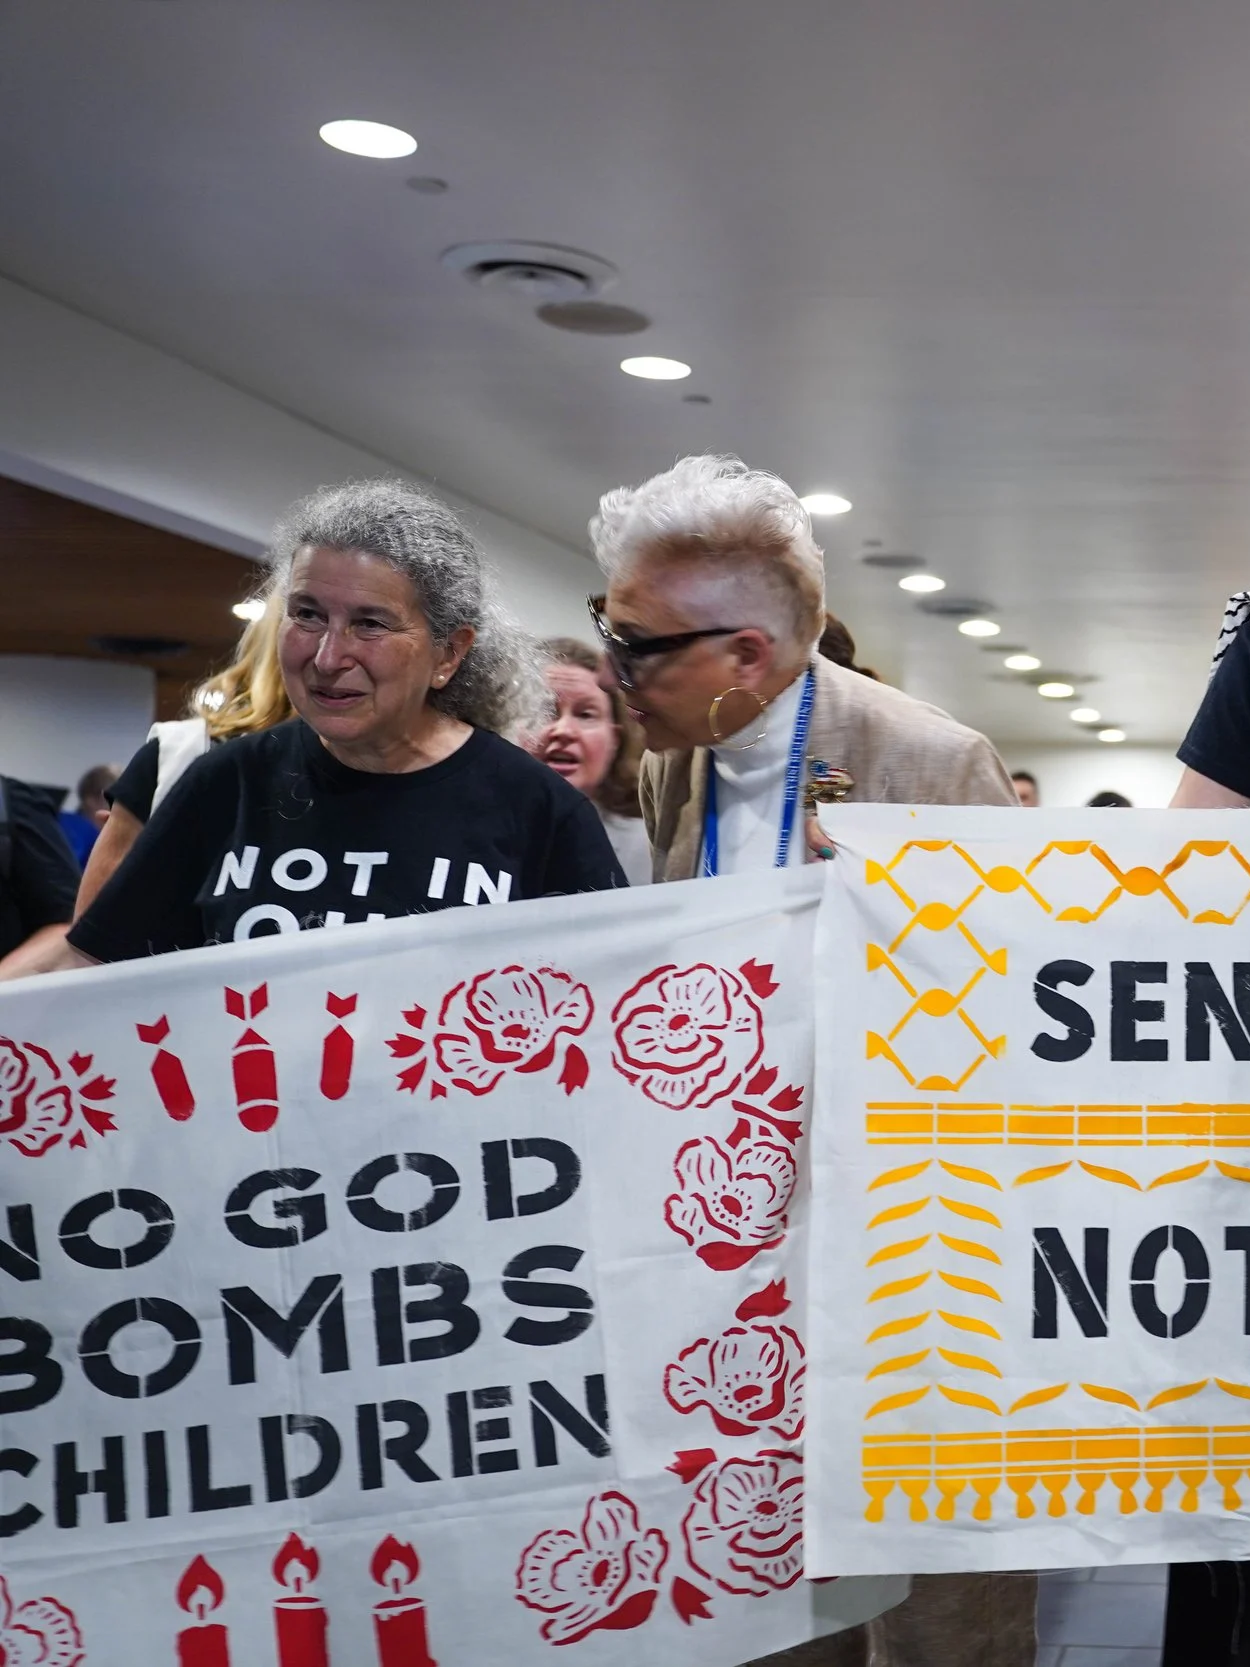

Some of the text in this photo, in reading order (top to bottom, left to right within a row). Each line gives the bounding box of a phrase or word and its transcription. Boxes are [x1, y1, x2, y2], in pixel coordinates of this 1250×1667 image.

[213, 846, 512, 905] NOT IN
[224, 1138, 582, 1250] GOD
[0, 1245, 594, 1415] BOMBS
[0, 1373, 611, 1538] CHILDREN
